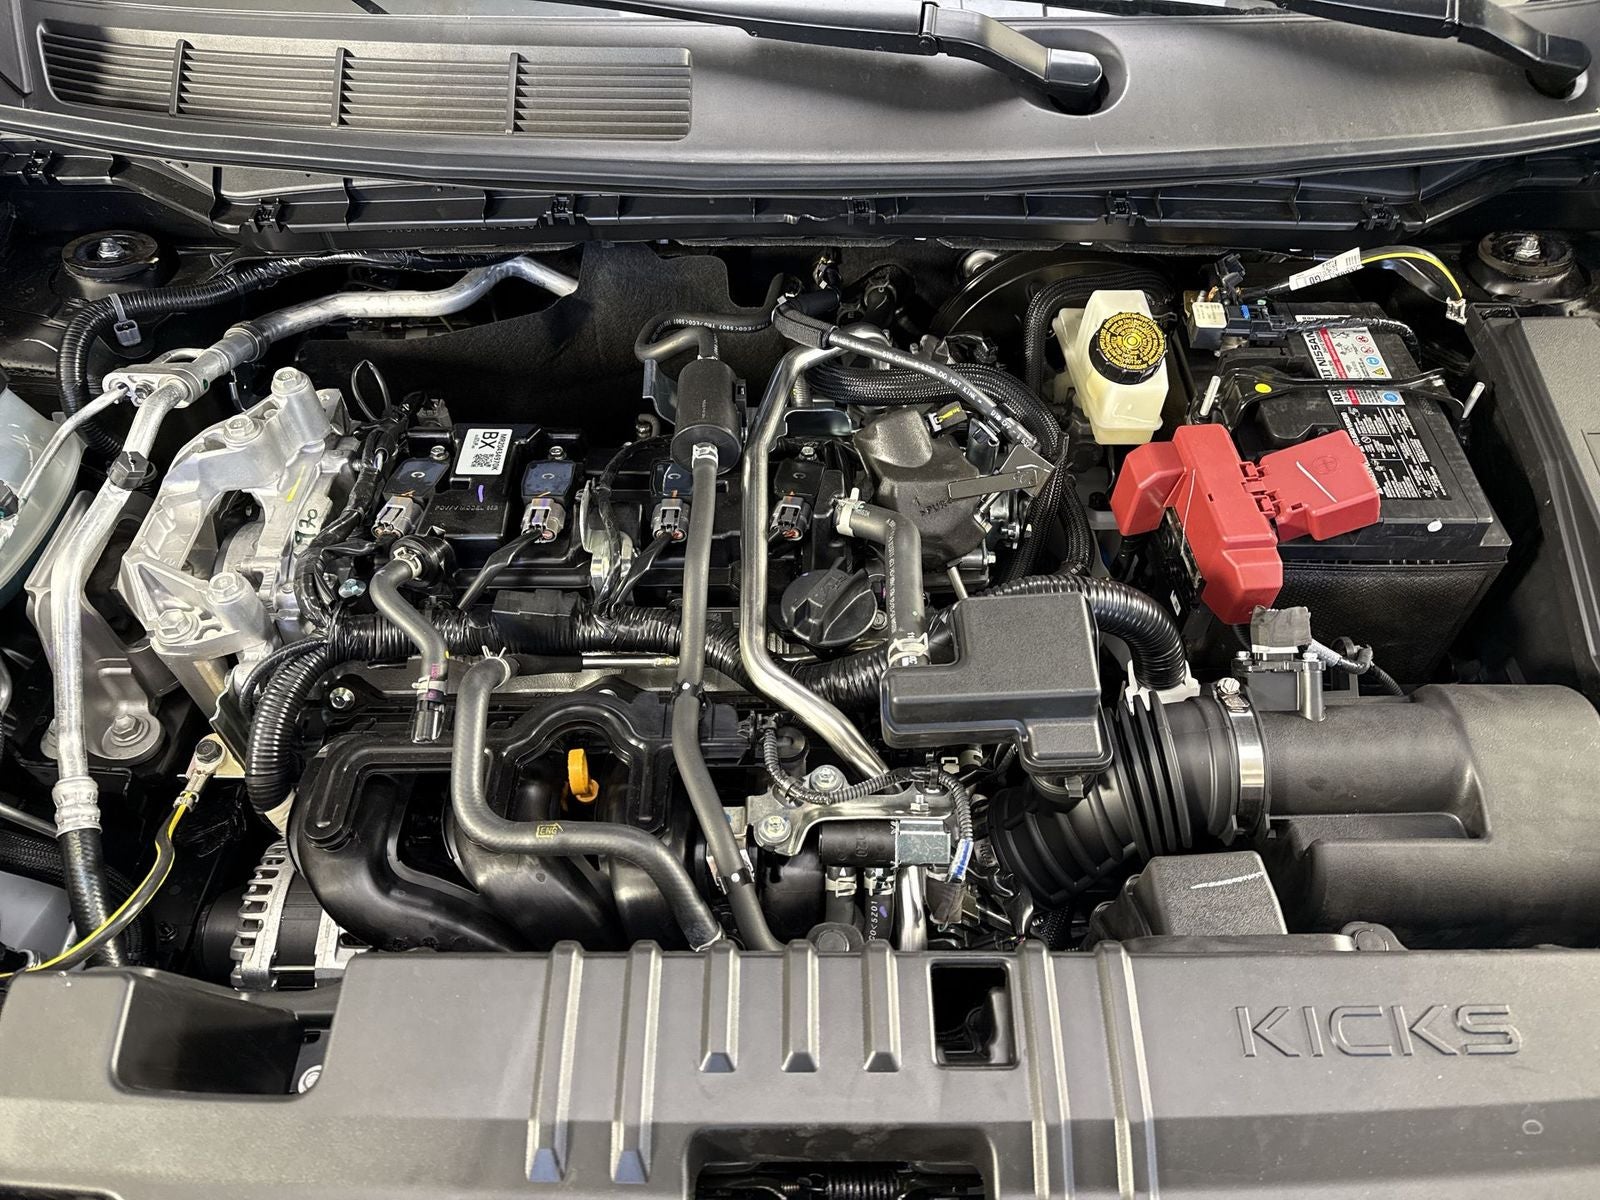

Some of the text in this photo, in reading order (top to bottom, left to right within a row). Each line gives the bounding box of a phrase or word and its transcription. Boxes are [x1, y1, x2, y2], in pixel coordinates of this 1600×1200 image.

[1304, 330, 1327, 365] NISSAN
[949, 378, 962, 388] NOT
[962, 387, 977, 400] KINK
[482, 431, 499, 450] BX
[539, 826, 558, 835] ENG
[1234, 1003, 1523, 1057] KICKS
